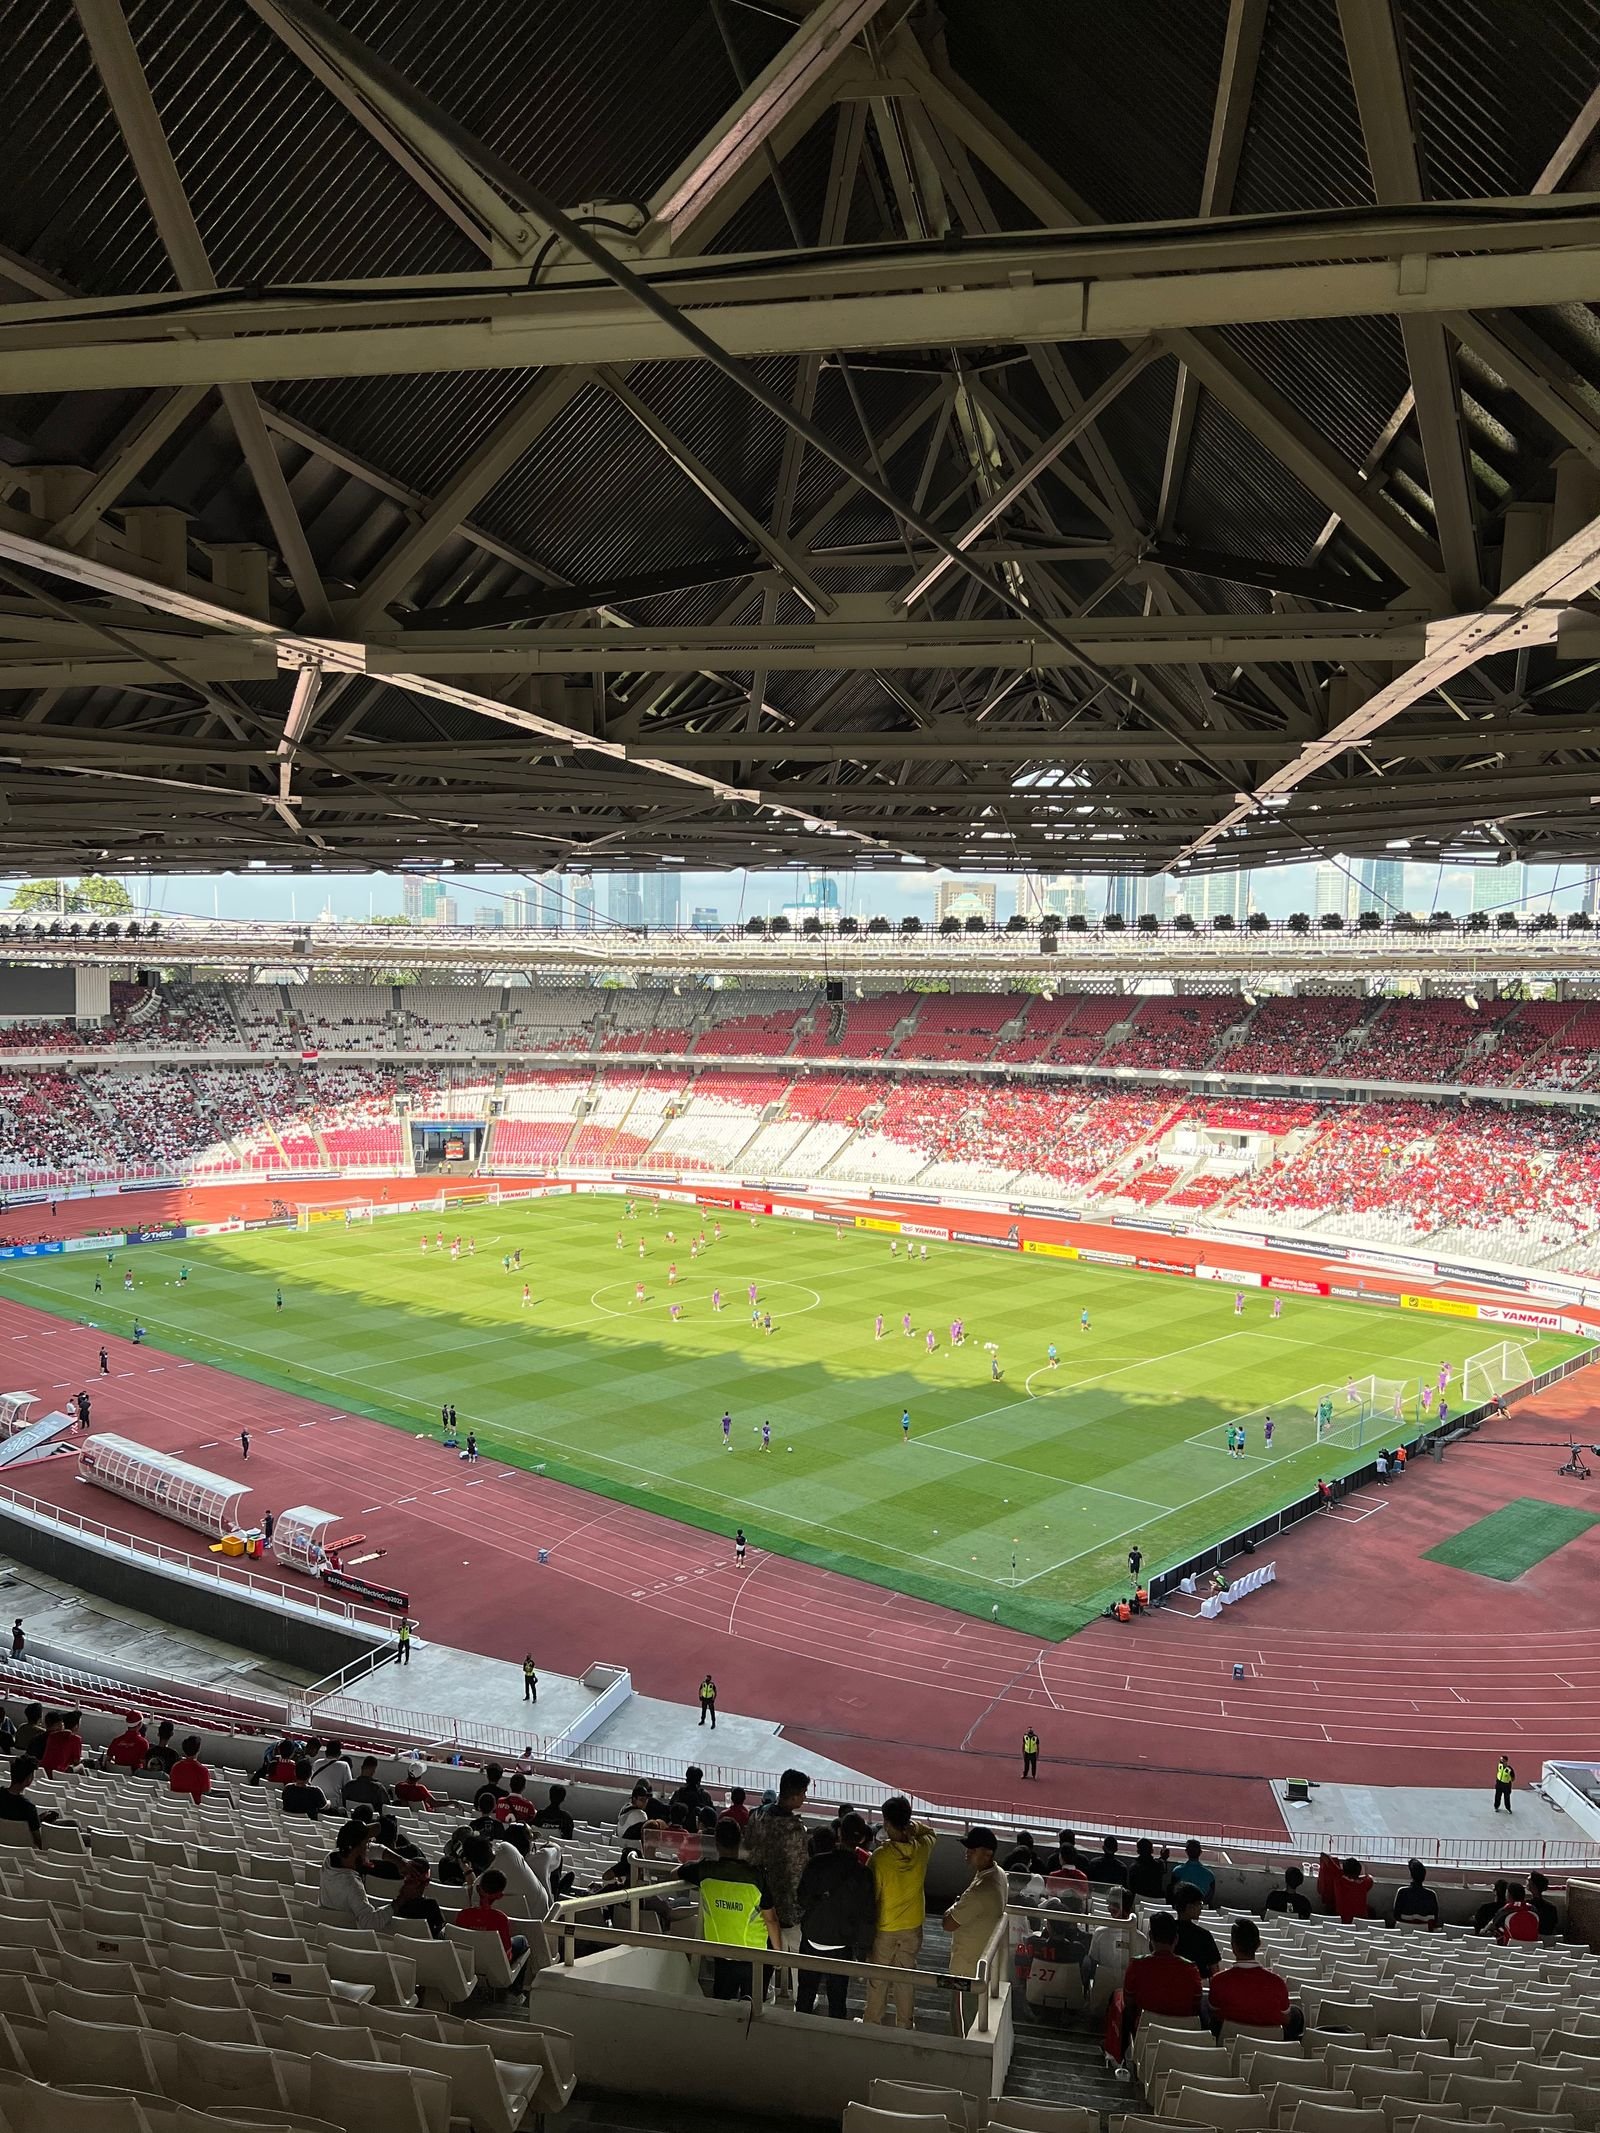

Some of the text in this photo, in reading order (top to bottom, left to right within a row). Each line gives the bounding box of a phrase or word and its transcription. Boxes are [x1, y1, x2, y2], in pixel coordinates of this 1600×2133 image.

[502, 1191, 529, 1199] YANMAR
[915, 1227, 947, 1238] YANMAR
[1331, 1287, 1358, 1297] ONSIDE
[1502, 1311, 1558, 1326] YANMAR
[327, 1576, 403, 1605] #AFFMitsubishiElectricCup2022
[715, 1899, 744, 1912] STEWARD
